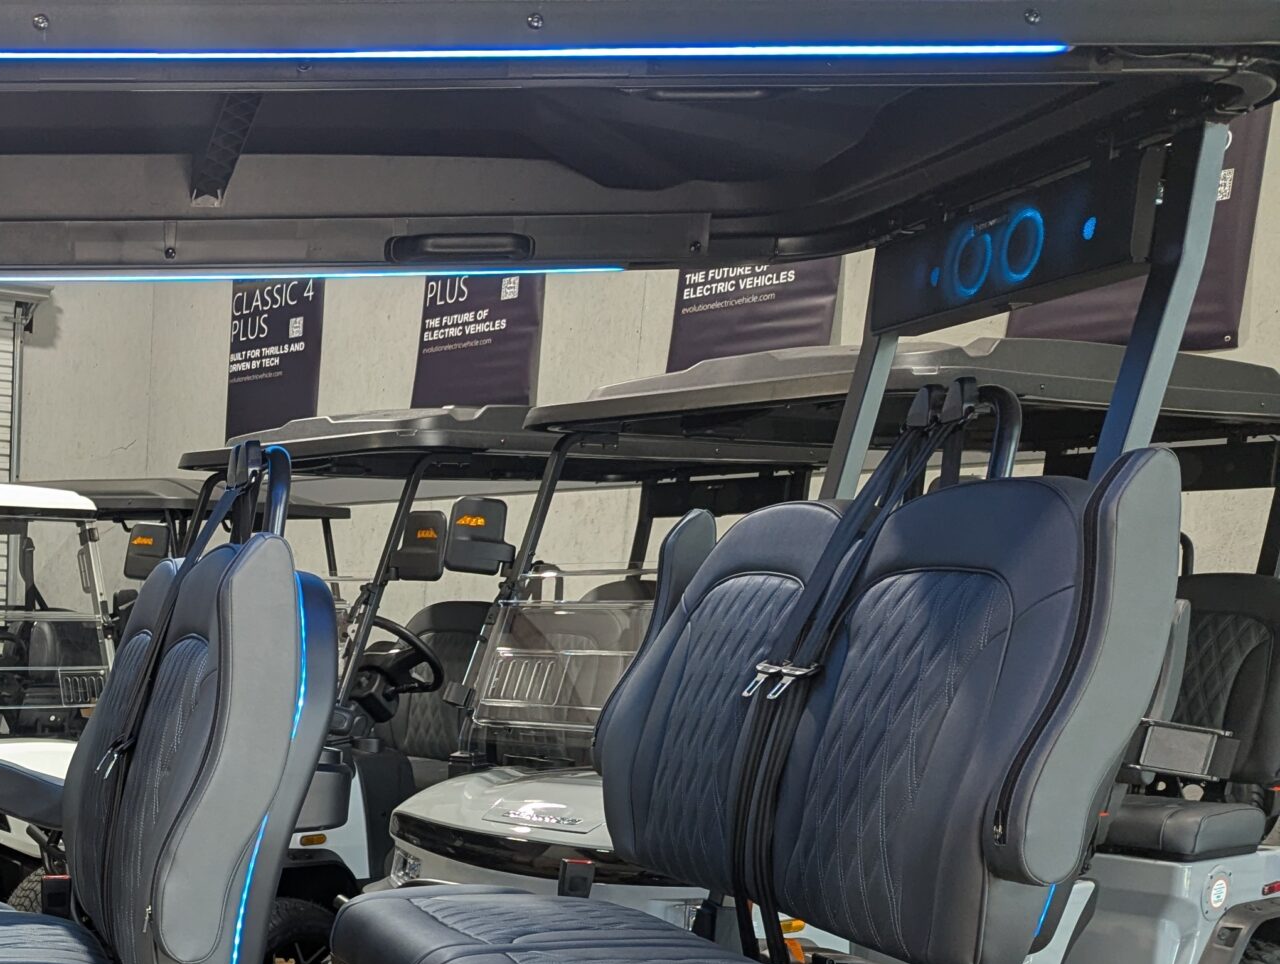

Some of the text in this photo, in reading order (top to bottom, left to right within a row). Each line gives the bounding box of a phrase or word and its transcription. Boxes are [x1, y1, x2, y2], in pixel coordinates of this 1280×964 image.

[683, 270, 796, 299] ELECTRIC VEHICLES
[685, 270, 706, 285] THE
[708, 266, 752, 281] FUTURE
[232, 278, 314, 316] CLASSIC 4
[427, 275, 469, 307] PLUS
[681, 292, 776, 314] evolutionelectricvehicle.com
[231, 314, 268, 343] PLUS
[423, 318, 507, 341] ELECTRIC VEHICLES
[425, 308, 489, 329] THE FUTURE OF
[247, 348, 260, 359] FOR
[261, 343, 289, 357] THRILLS
[289, 341, 305, 353] AND
[251, 359, 261, 370] BY
[262, 356, 280, 368] TECH
